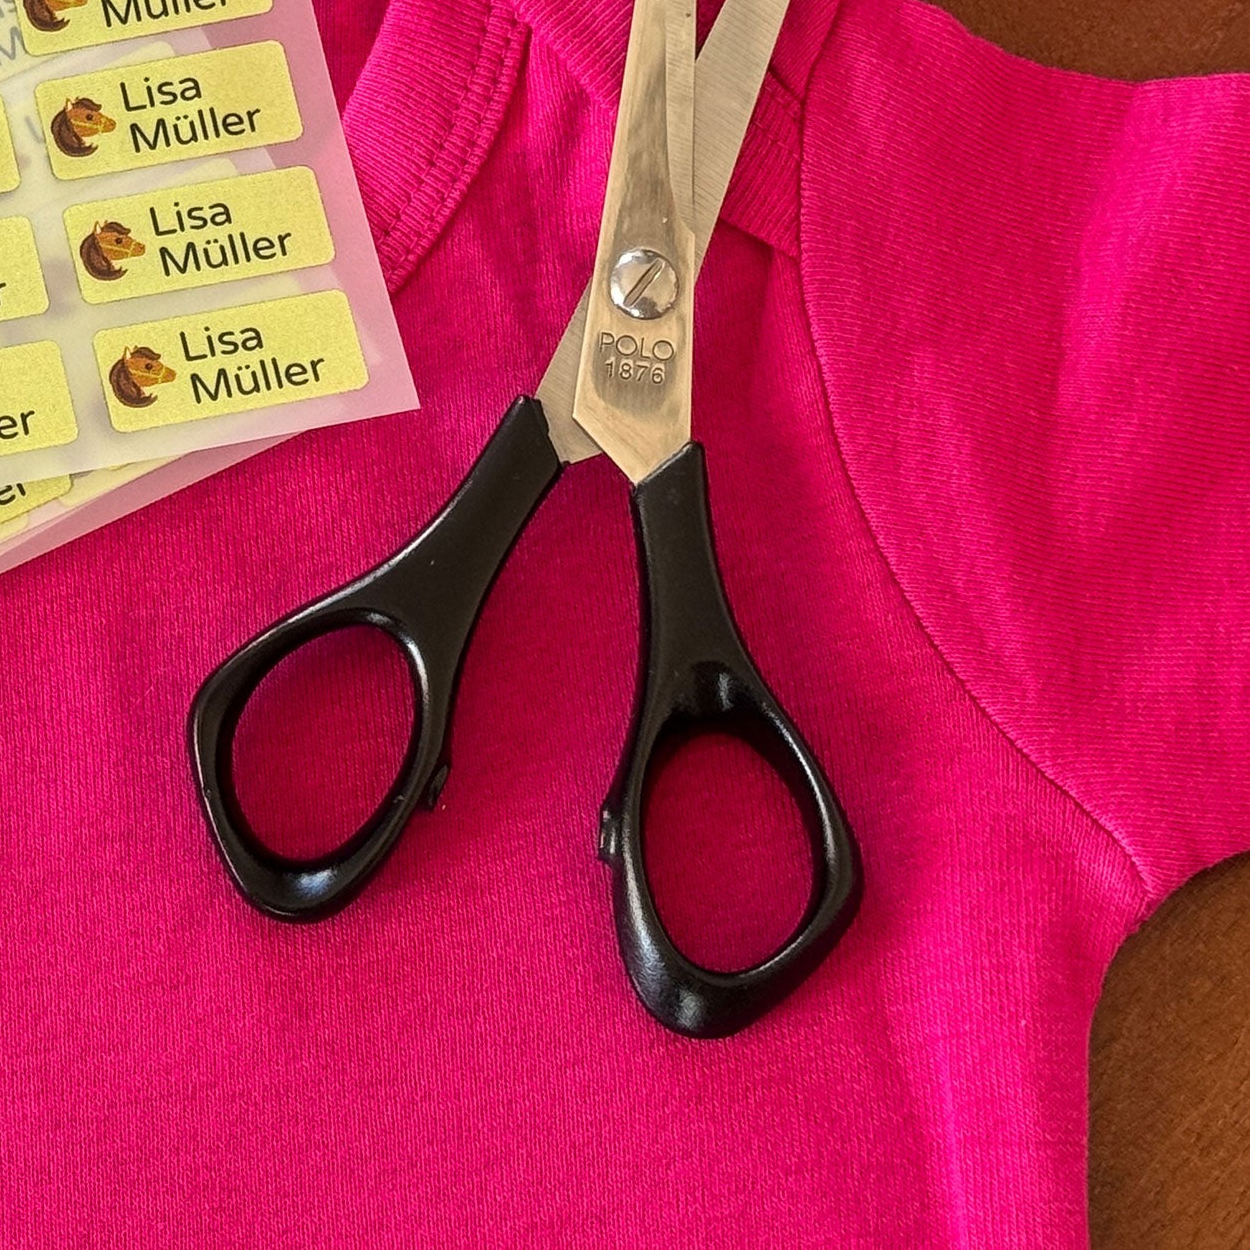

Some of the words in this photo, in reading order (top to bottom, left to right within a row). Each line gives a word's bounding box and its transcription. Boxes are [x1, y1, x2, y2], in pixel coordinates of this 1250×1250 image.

[119, 76, 202, 112] Lisa
[129, 106, 261, 154] Müller
[149, 201, 233, 237] Lisa
[158, 231, 292, 277] Müller
[179, 326, 264, 362] Lisa
[599, 332, 675, 361] POLO
[189, 357, 325, 405] Müller
[604, 358, 666, 385] 1876
